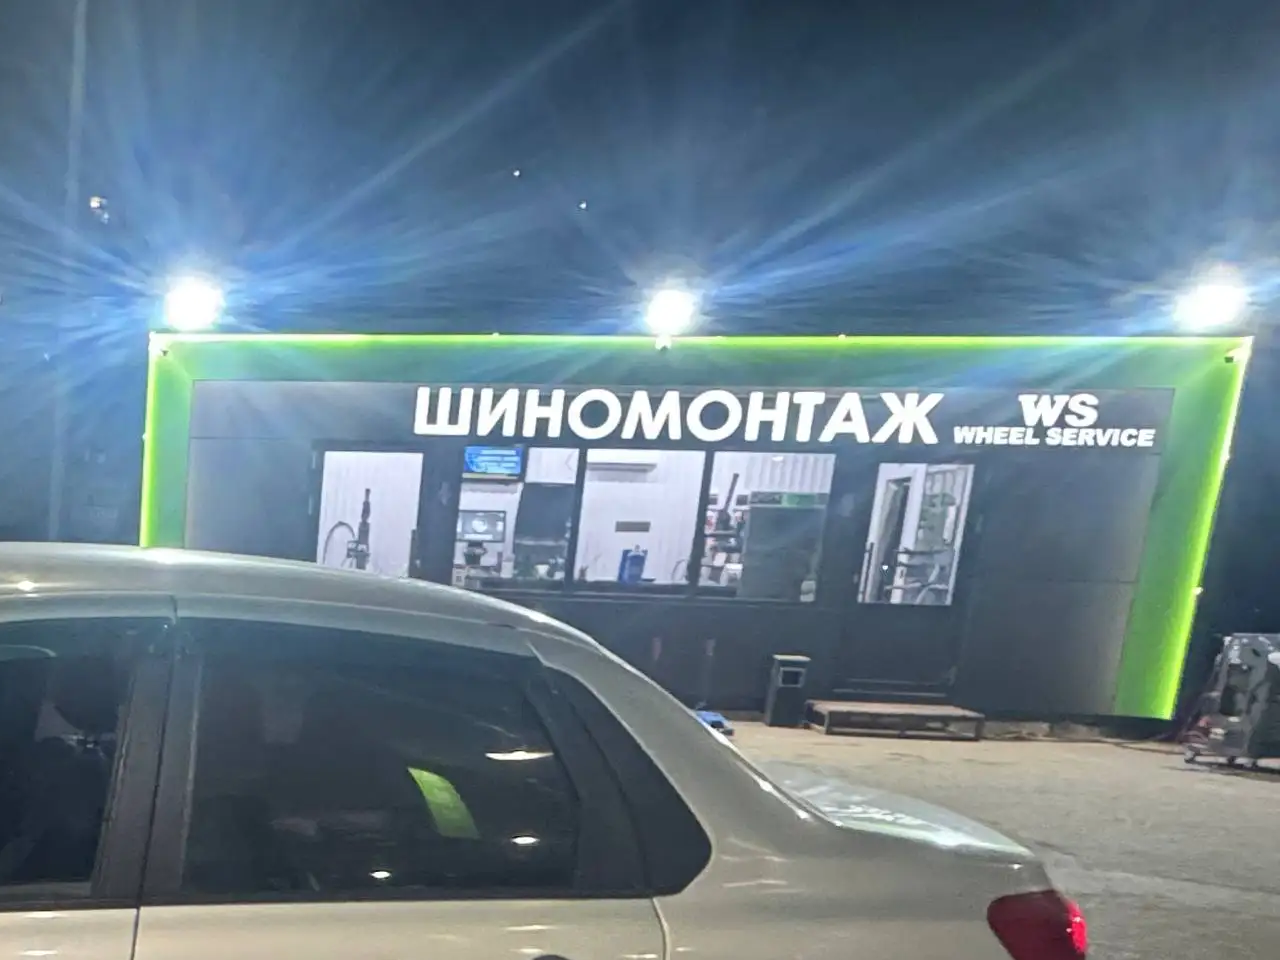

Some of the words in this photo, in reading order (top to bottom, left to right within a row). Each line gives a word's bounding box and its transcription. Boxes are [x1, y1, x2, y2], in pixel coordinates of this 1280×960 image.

[413, 386, 944, 444] ШИНОМОНТАЖ
[1018, 393, 1099, 427] WS
[953, 426, 1040, 445] WHEEL
[1045, 427, 1156, 447] SERVICE
